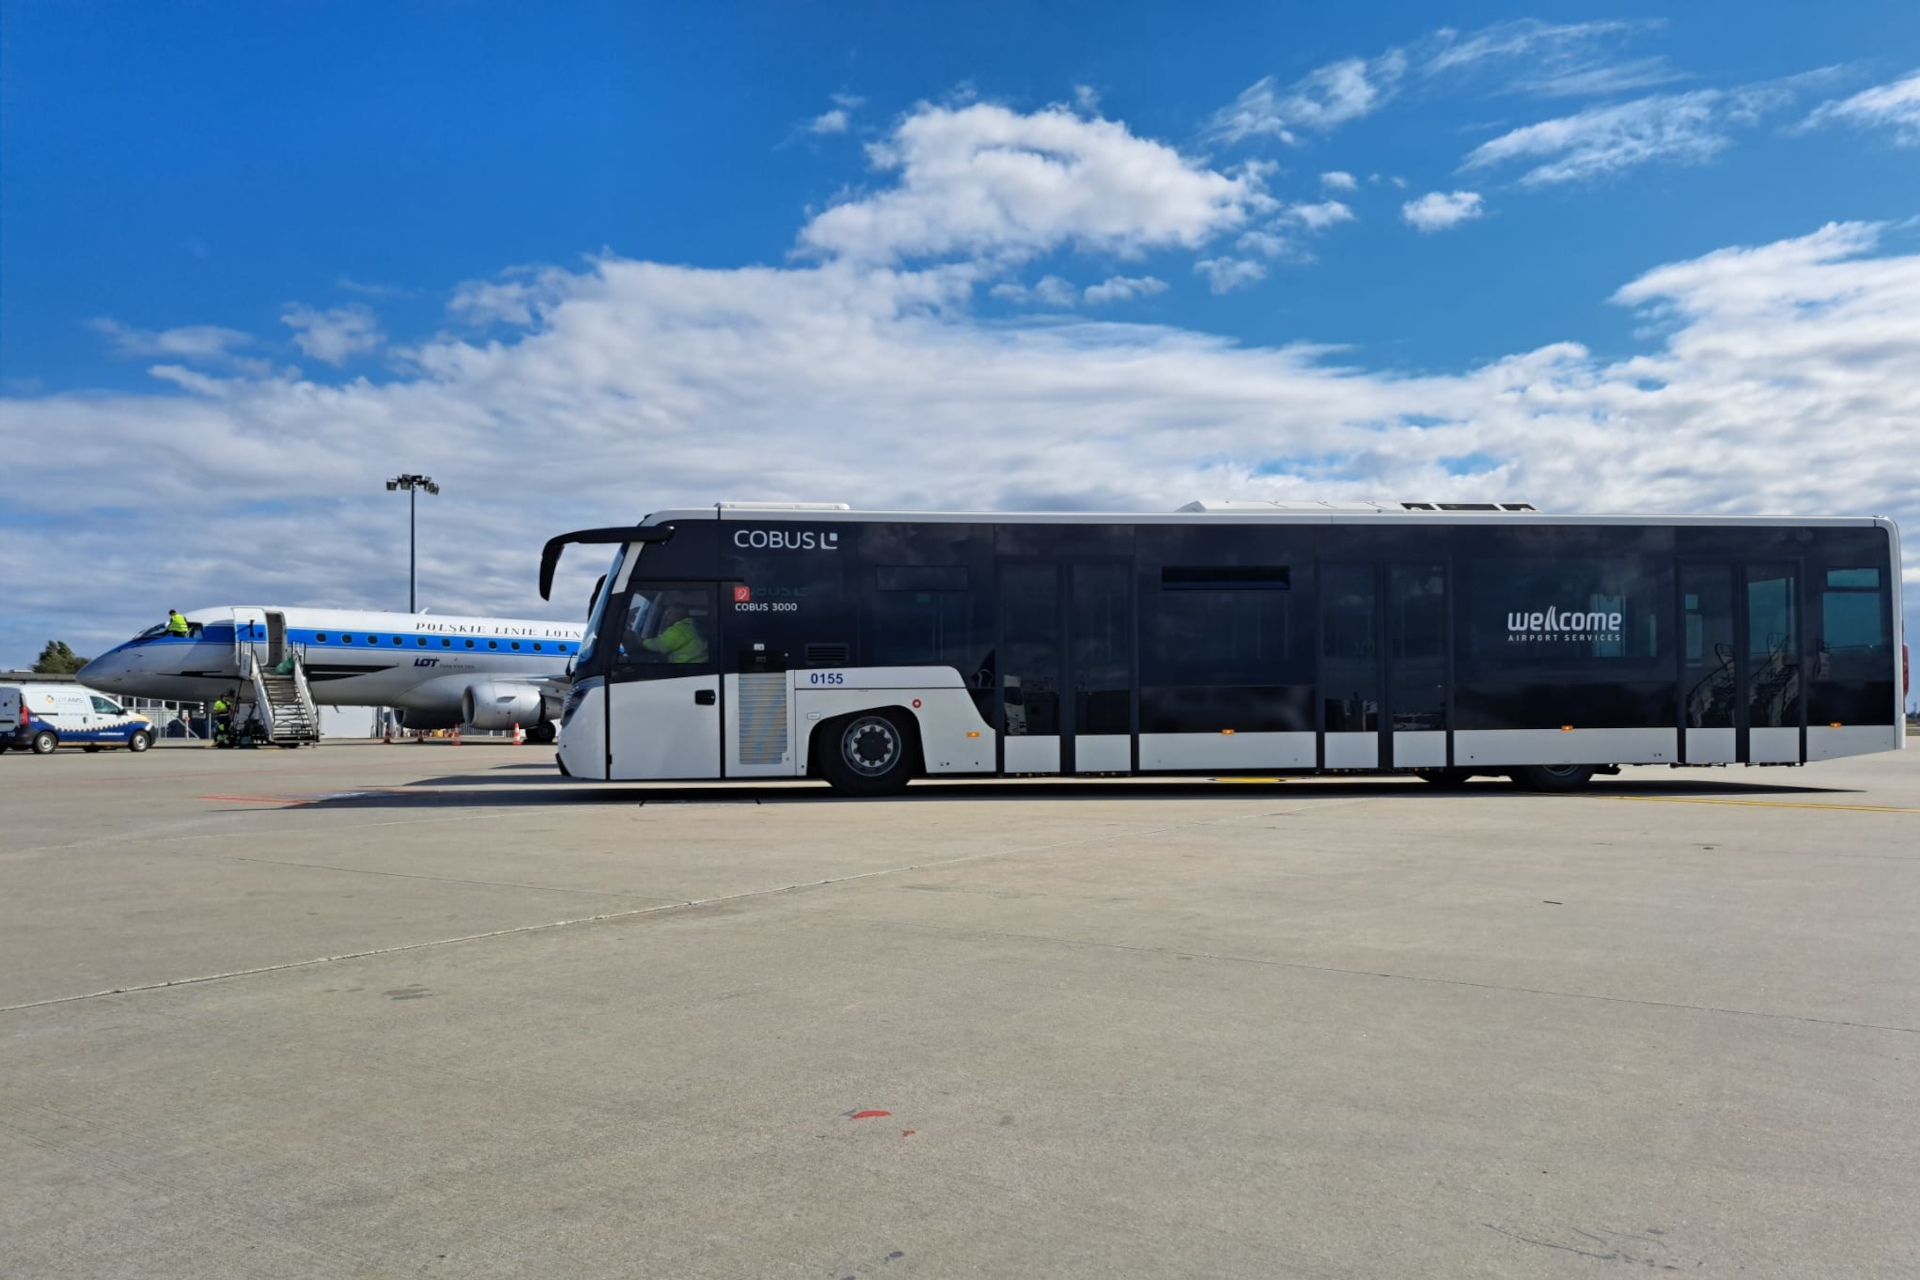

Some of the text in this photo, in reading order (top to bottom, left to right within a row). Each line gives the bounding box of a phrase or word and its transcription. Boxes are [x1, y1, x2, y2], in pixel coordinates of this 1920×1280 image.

[734, 530, 815, 549] COBUS
[735, 603, 797, 611] COBUS 3000
[1507, 605, 1622, 630] welcome
[416, 623, 486, 634] POLSKIE
[494, 627, 537, 636] LINIE
[414, 657, 439, 667] LOT
[811, 673, 843, 684] 0155
